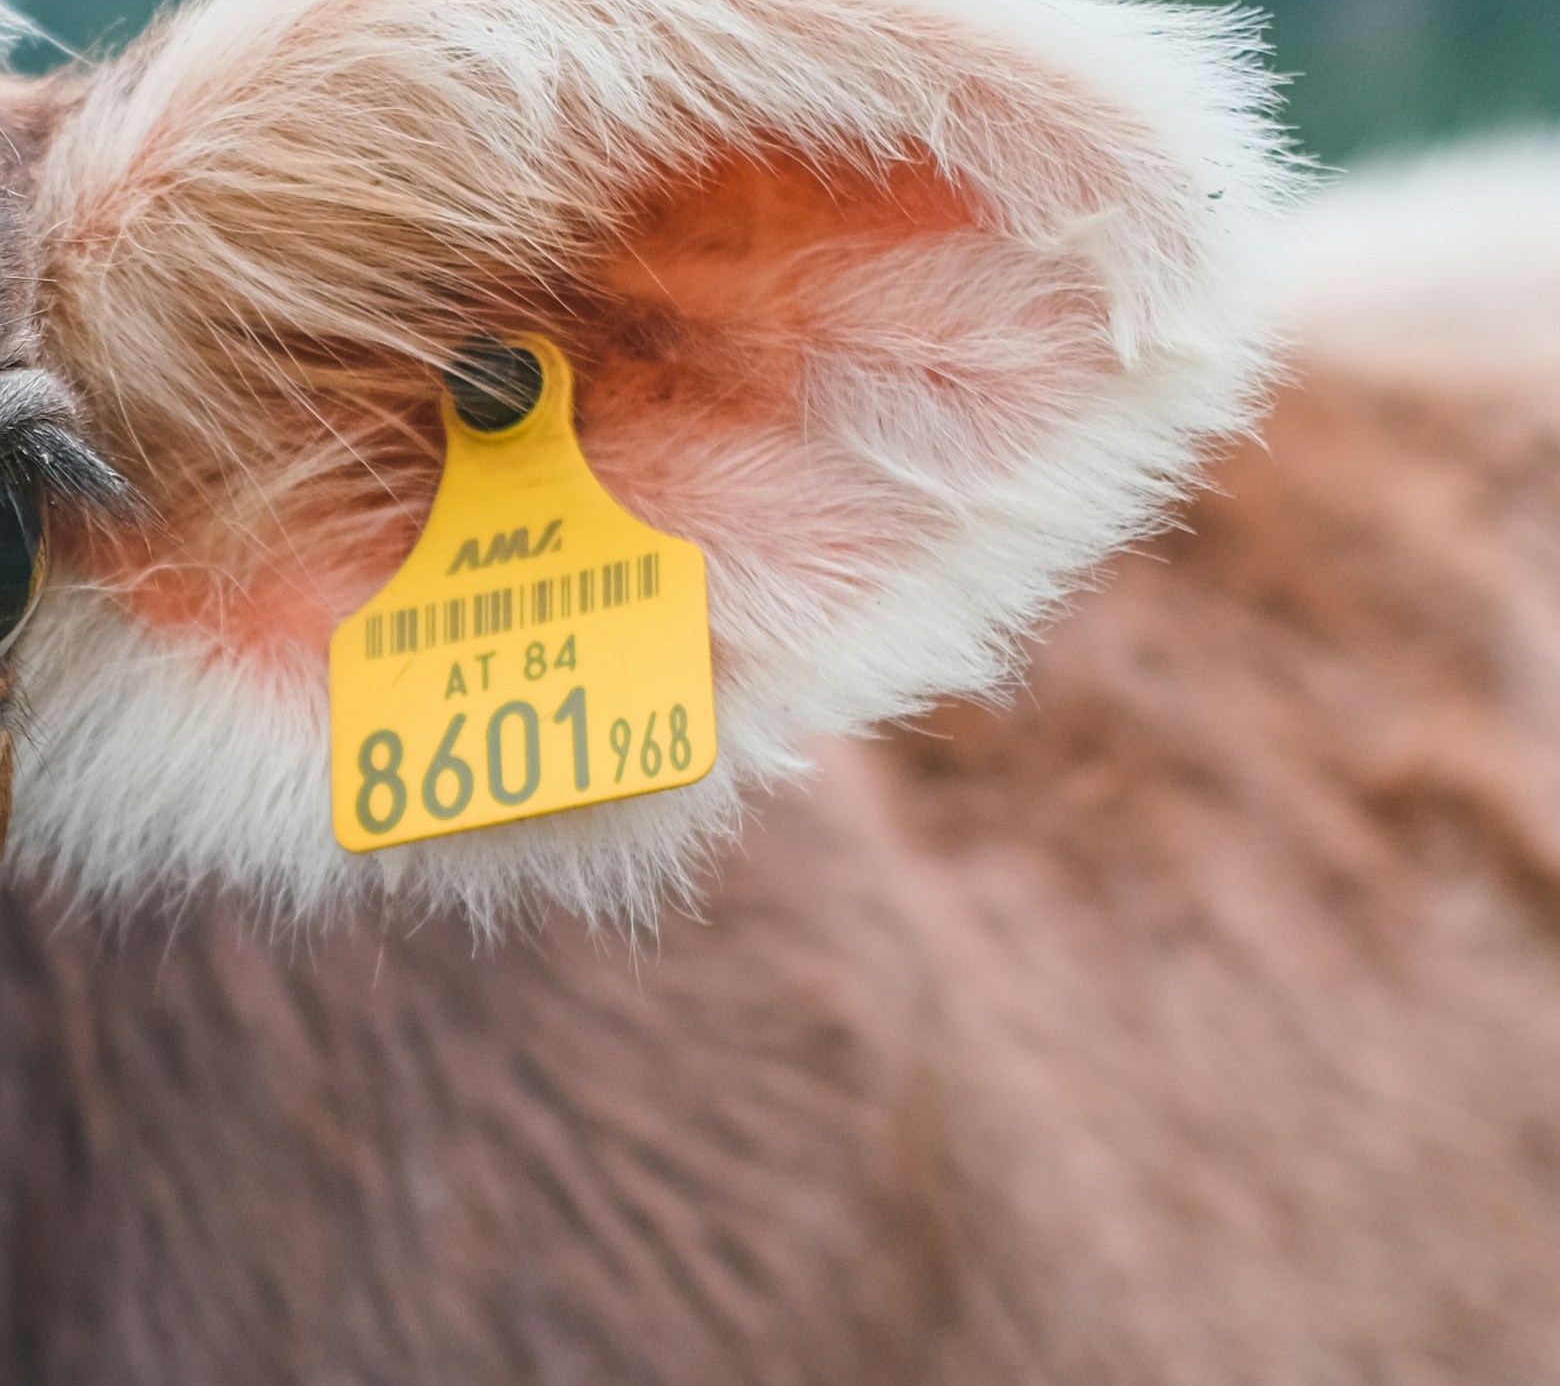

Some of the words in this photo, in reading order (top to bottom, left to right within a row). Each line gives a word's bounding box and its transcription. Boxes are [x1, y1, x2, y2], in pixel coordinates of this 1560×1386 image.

[444, 651, 497, 701] AT
[523, 634, 577, 682] 84
[355, 685, 591, 835] 8601
[609, 704, 692, 784] 968
